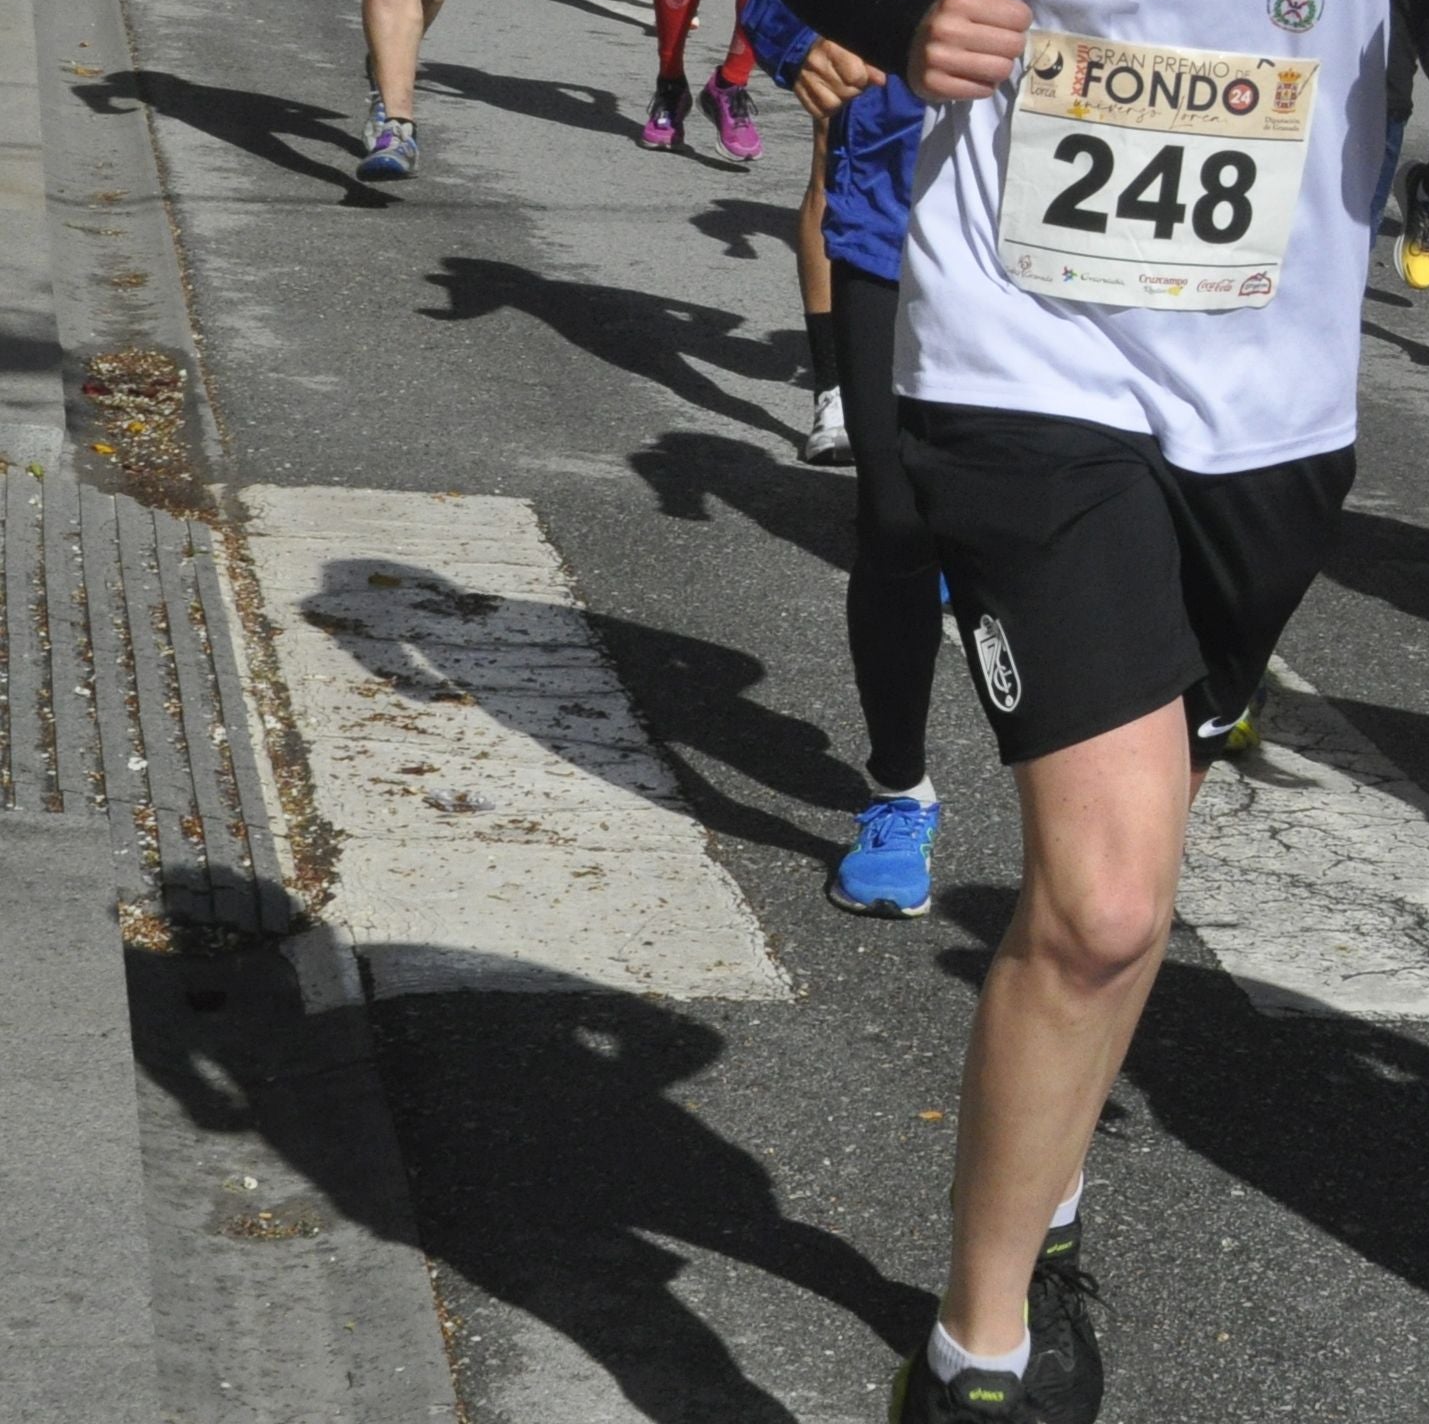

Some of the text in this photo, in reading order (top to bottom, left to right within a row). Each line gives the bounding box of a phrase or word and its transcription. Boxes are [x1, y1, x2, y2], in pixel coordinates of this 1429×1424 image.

[1081, 60, 1260, 116] FONDO
[1087, 46, 1146, 69] GRAN
[1152, 54, 1230, 78] PREMIO
[1042, 133, 1257, 245] 248
